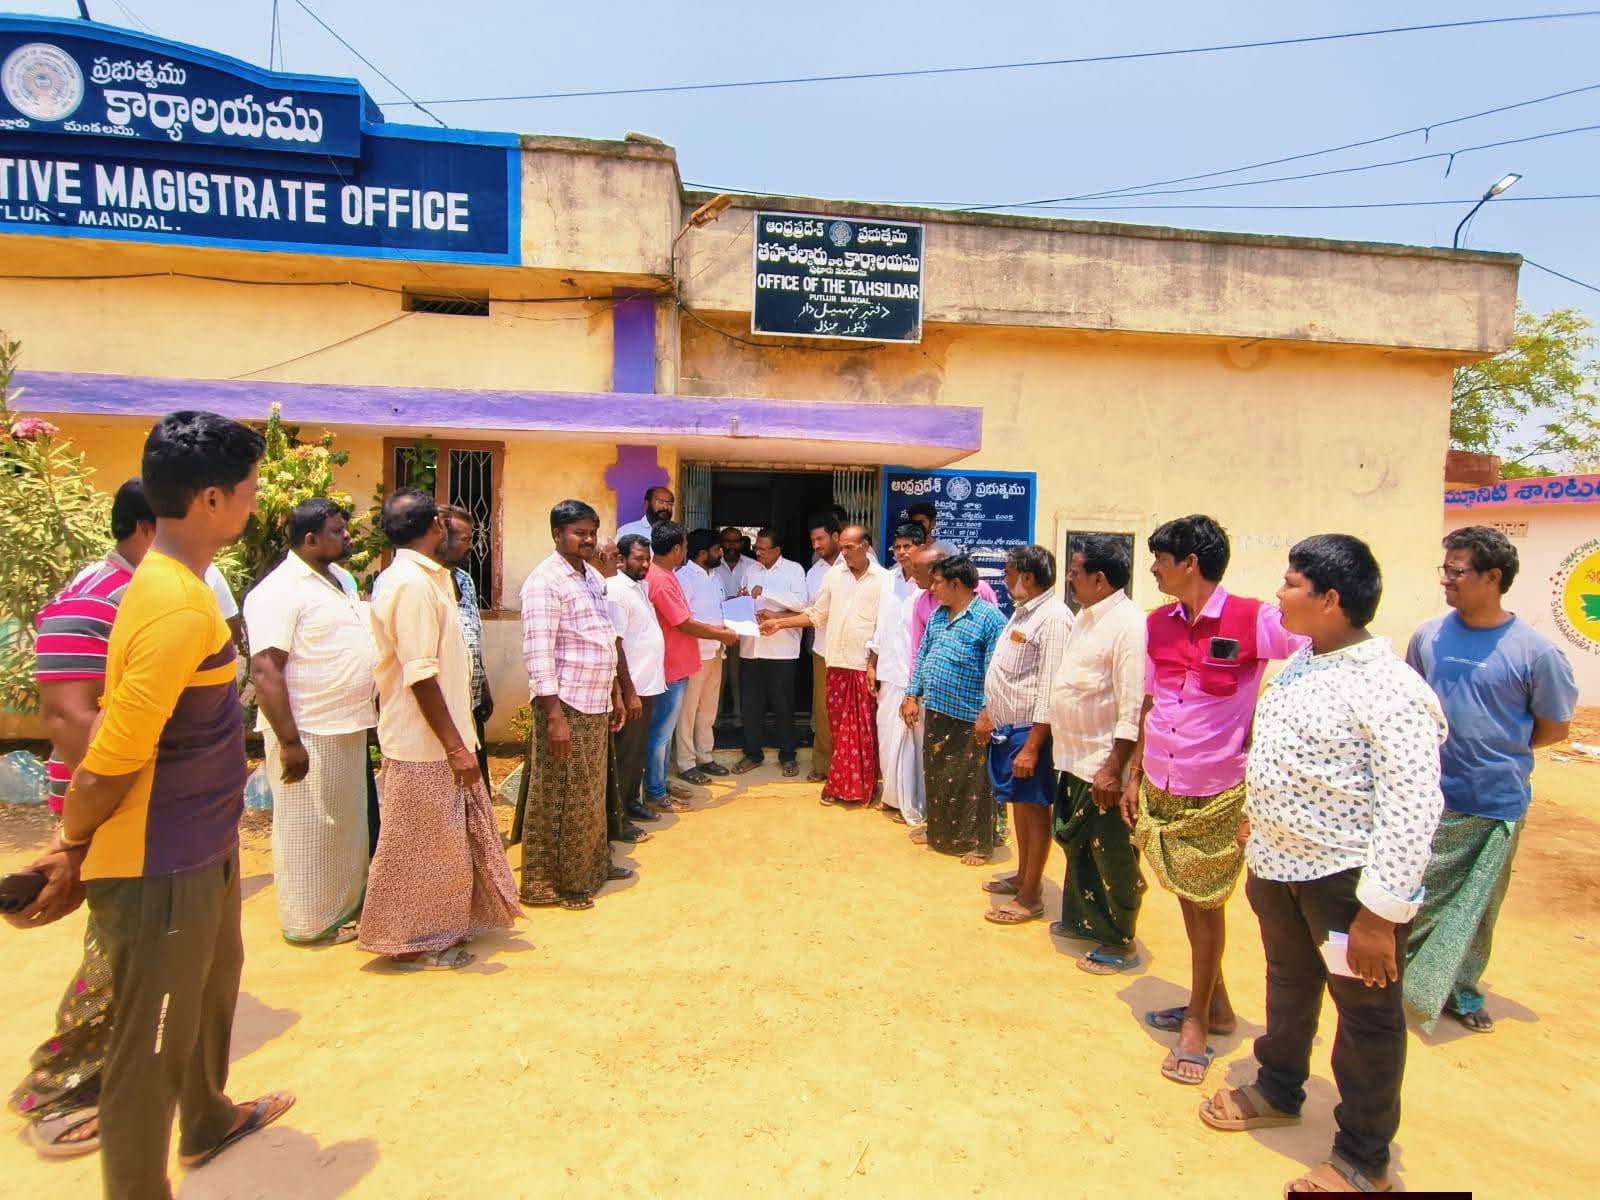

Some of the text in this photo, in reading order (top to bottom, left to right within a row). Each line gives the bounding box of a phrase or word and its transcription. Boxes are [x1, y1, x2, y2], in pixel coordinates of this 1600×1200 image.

[91, 56, 187, 88] ప్రభుత్వము
[103, 89, 323, 143] కార్యాలయము
[0, 157, 469, 232] TIVE MAGISTRATE OFFICE
[78, 209, 182, 232] MANDAL.
[757, 273, 920, 300] OFFICE OF THE TAHSILDAR
[808, 293, 837, 302] PUTLUR
[1560, 538, 1599, 569] SWACHHA
